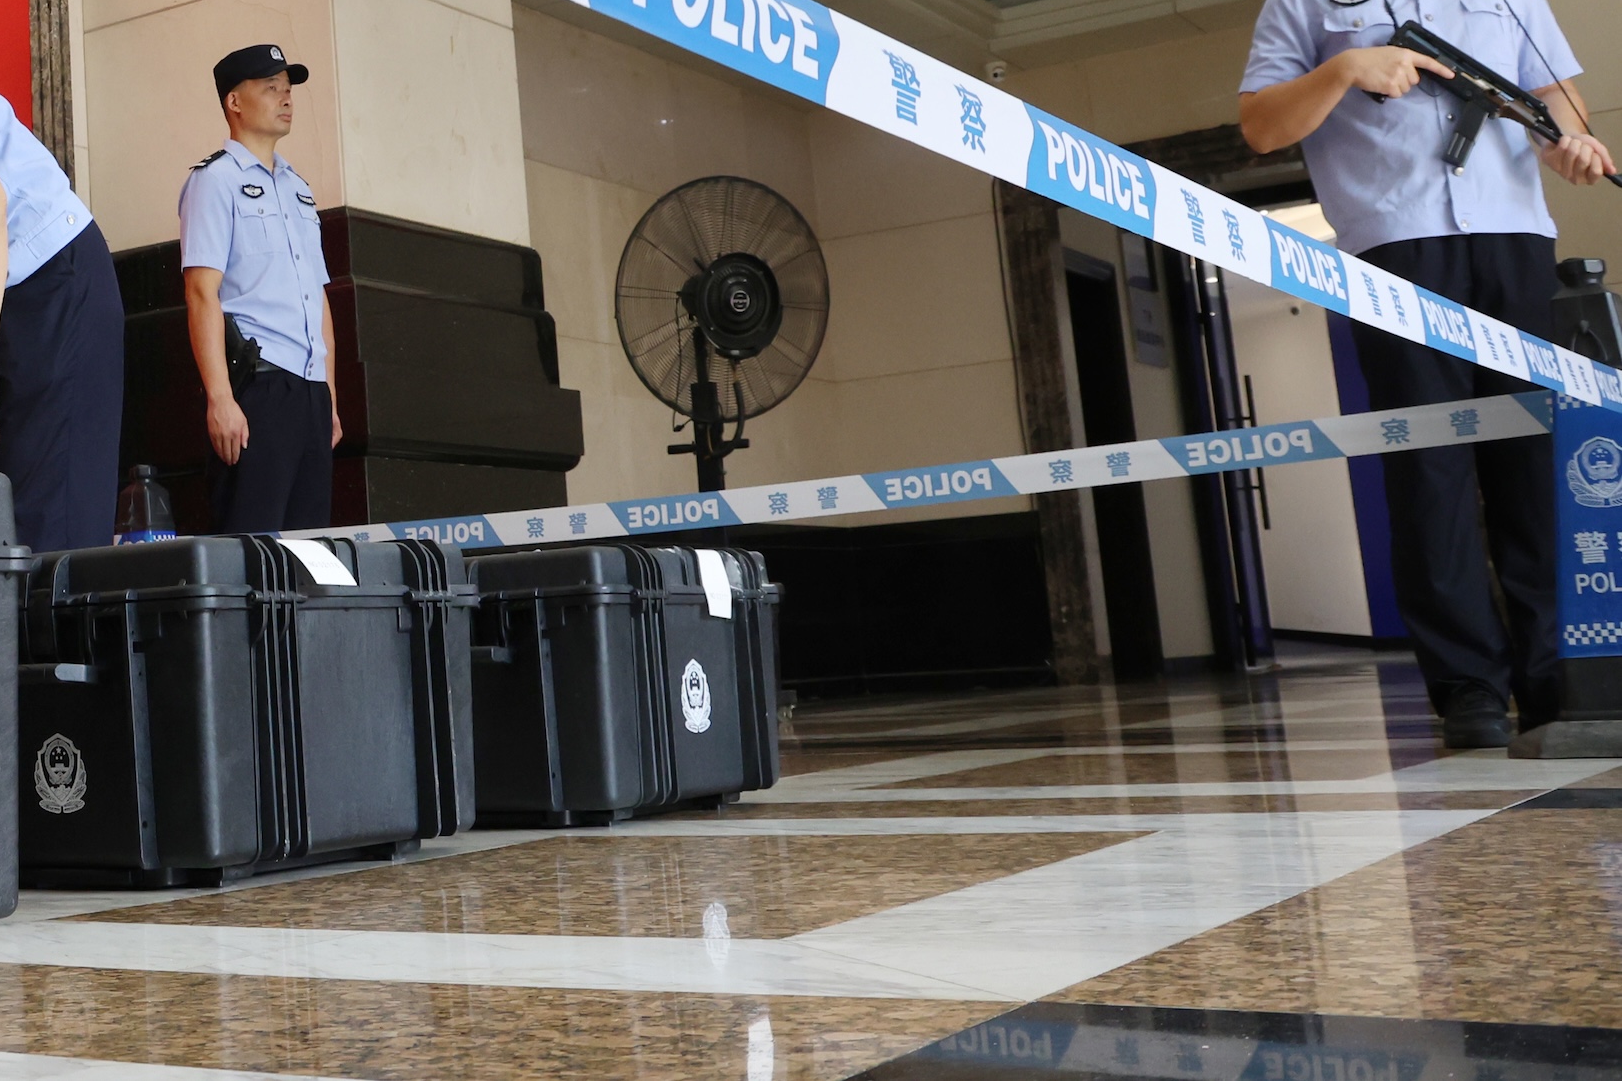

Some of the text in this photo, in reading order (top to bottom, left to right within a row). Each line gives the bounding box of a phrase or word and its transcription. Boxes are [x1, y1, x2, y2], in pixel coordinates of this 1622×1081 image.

[882, 49, 987, 155] 警察
[1036, 120, 1150, 220] POLICE
[1180, 187, 1247, 263] 警察
[1271, 229, 1348, 301] POLICE
[1419, 295, 1475, 351] POLICE
[1521, 339, 1564, 383] POLICE
[1573, 530, 1622, 565] 警
[1575, 571, 1622, 595] POL
